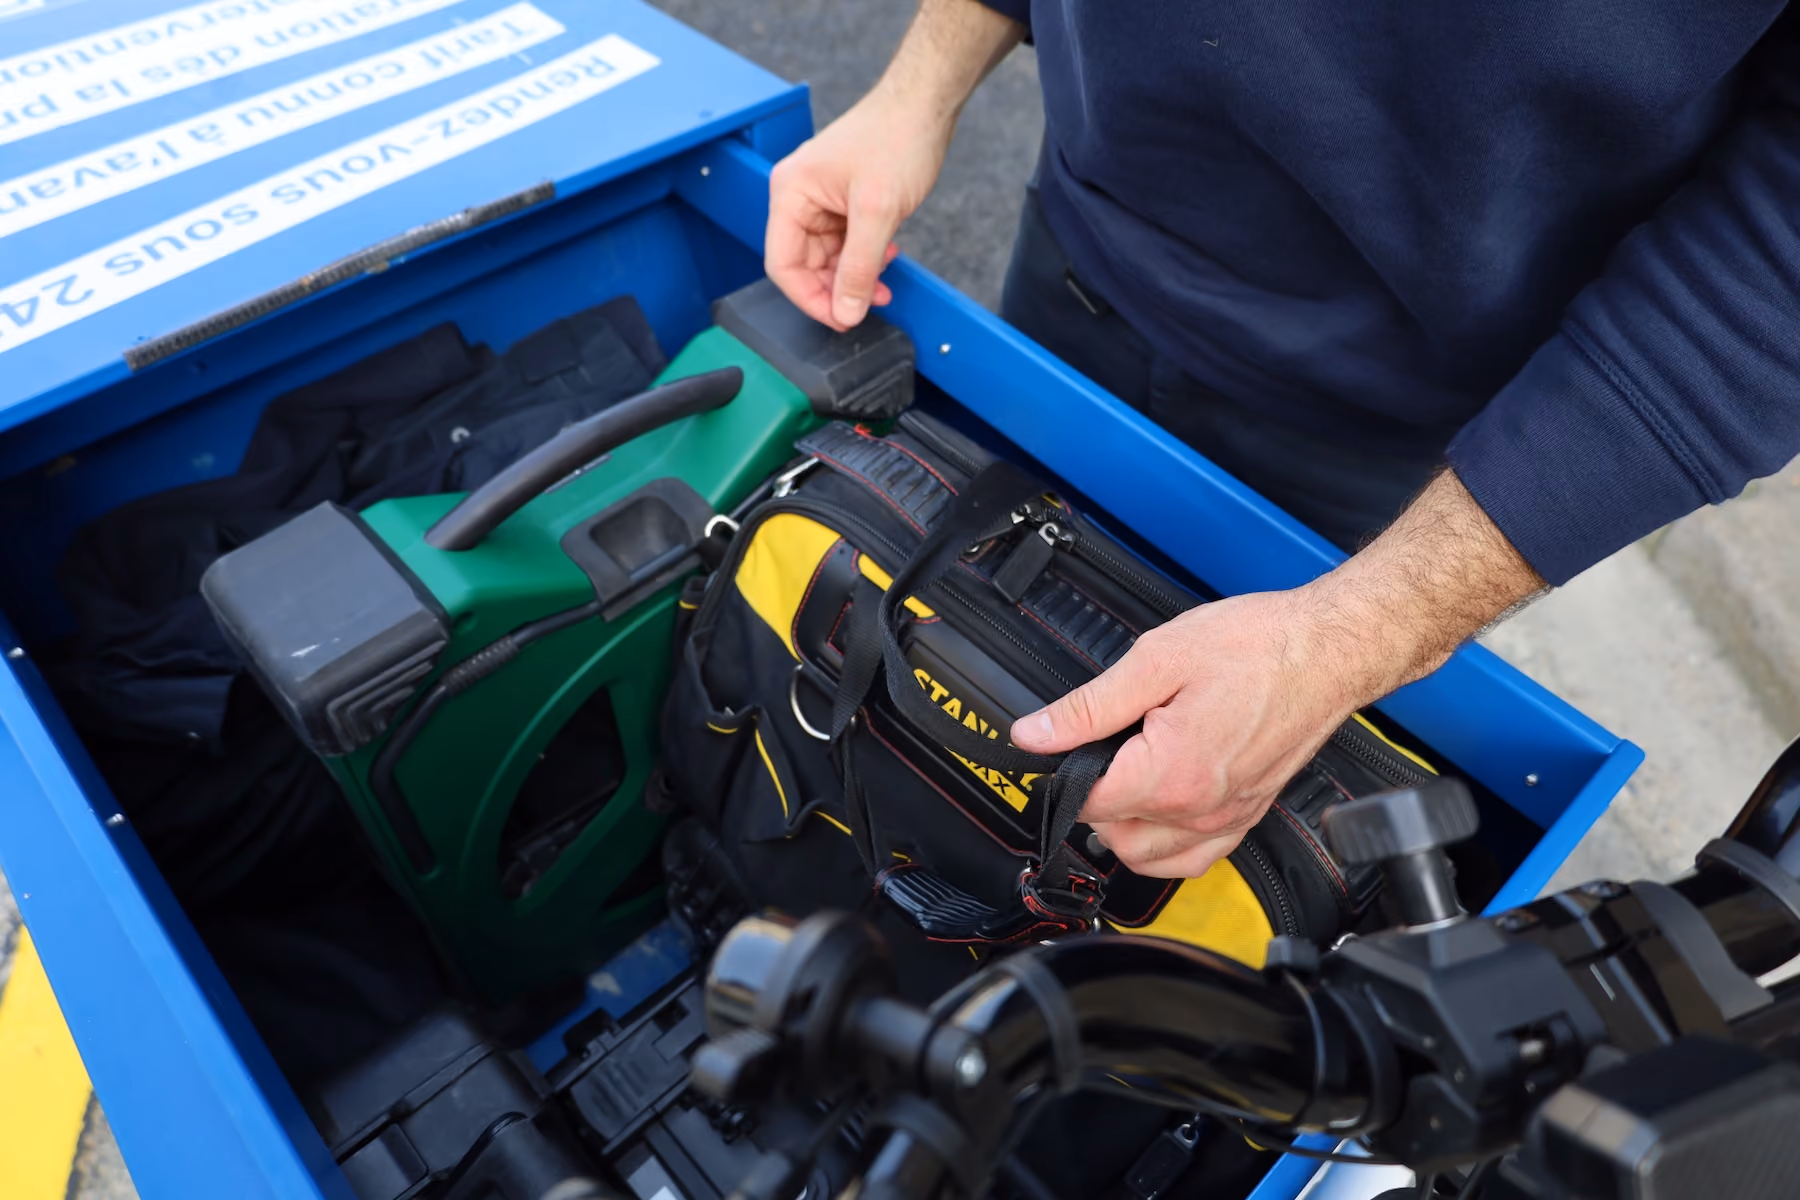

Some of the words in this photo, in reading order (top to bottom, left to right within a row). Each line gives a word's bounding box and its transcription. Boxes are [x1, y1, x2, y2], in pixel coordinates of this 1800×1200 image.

[254, 0, 420, 48] ration
[417, 19, 537, 70] Tarif
[75, 79, 131, 103] la
[139, 45, 241, 83] dès
[236, 60, 406, 128] connu
[186, 122, 228, 146] à
[271, 54, 619, 205] Rendez-vous
[104, 203, 260, 277] sous
[0, 274, 95, 338] 24
[913, 667, 1042, 788] STANY
